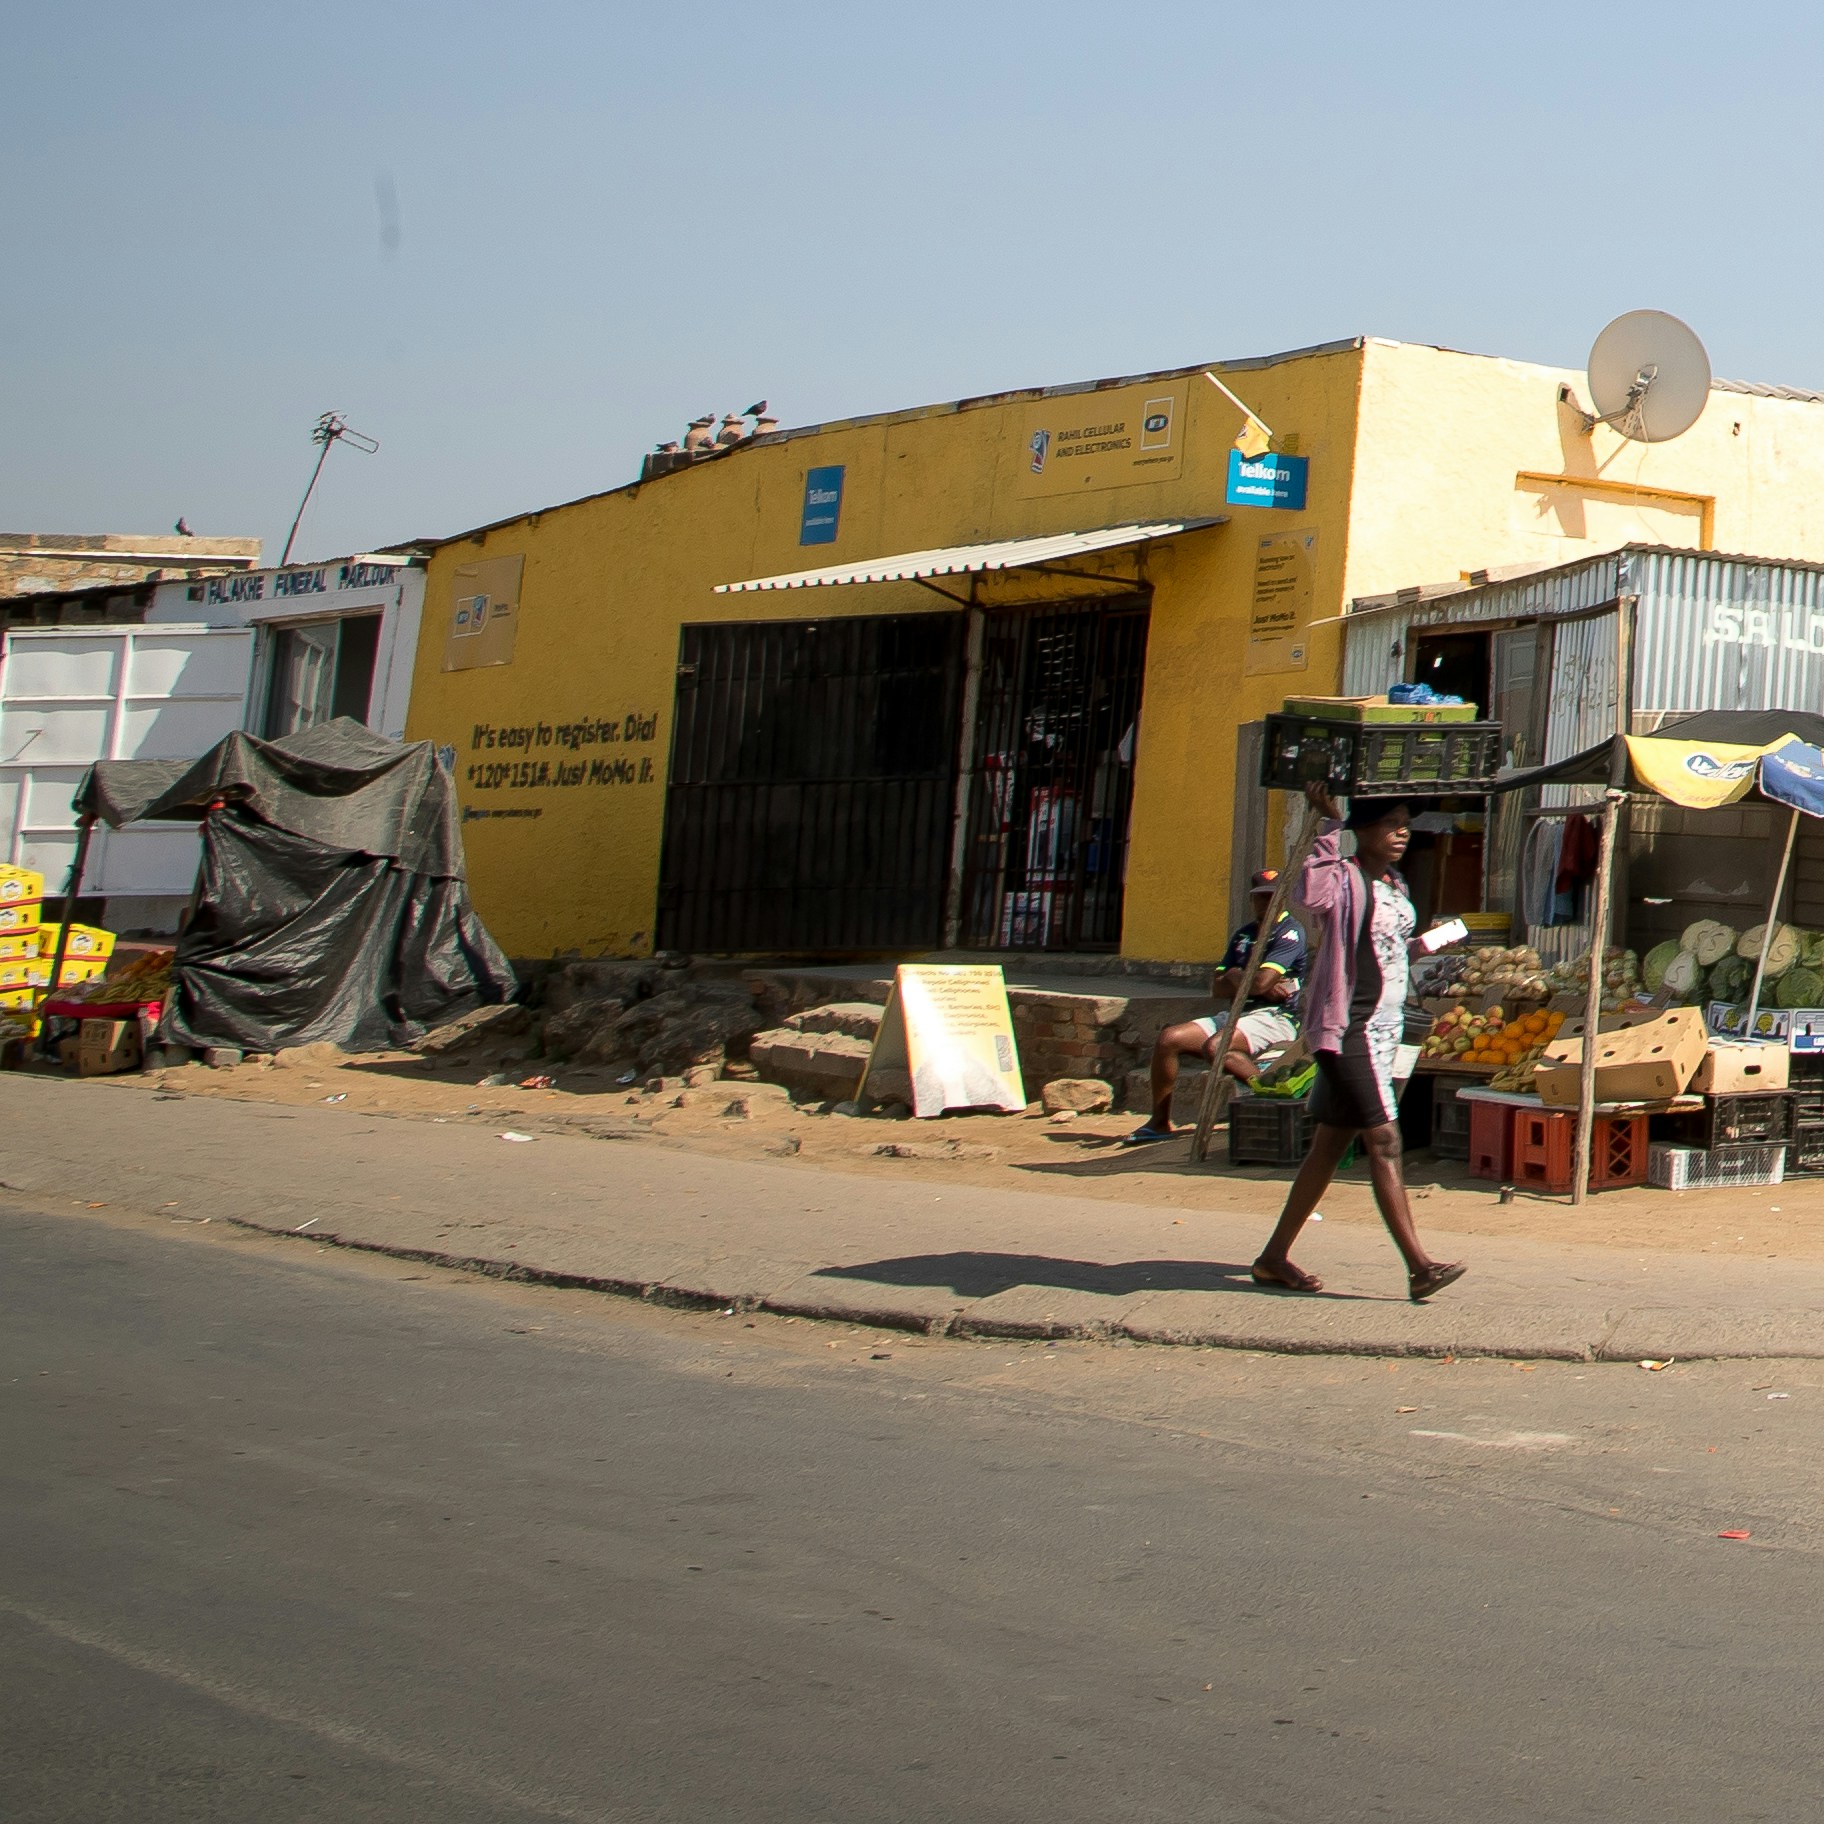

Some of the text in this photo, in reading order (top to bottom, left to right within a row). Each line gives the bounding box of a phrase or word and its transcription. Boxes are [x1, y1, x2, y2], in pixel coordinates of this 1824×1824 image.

[1058, 423, 1126, 442] RAHIL CELLULAR
[1055, 438, 1132, 459] AND ELECTRONICS
[1238, 461, 1291, 482] Telkom
[808, 488, 838, 505] Telkom
[472, 711, 659, 754] It's easy to register. Dial
[552, 758, 587, 787] Just
[588, 757, 636, 786] MoMo
